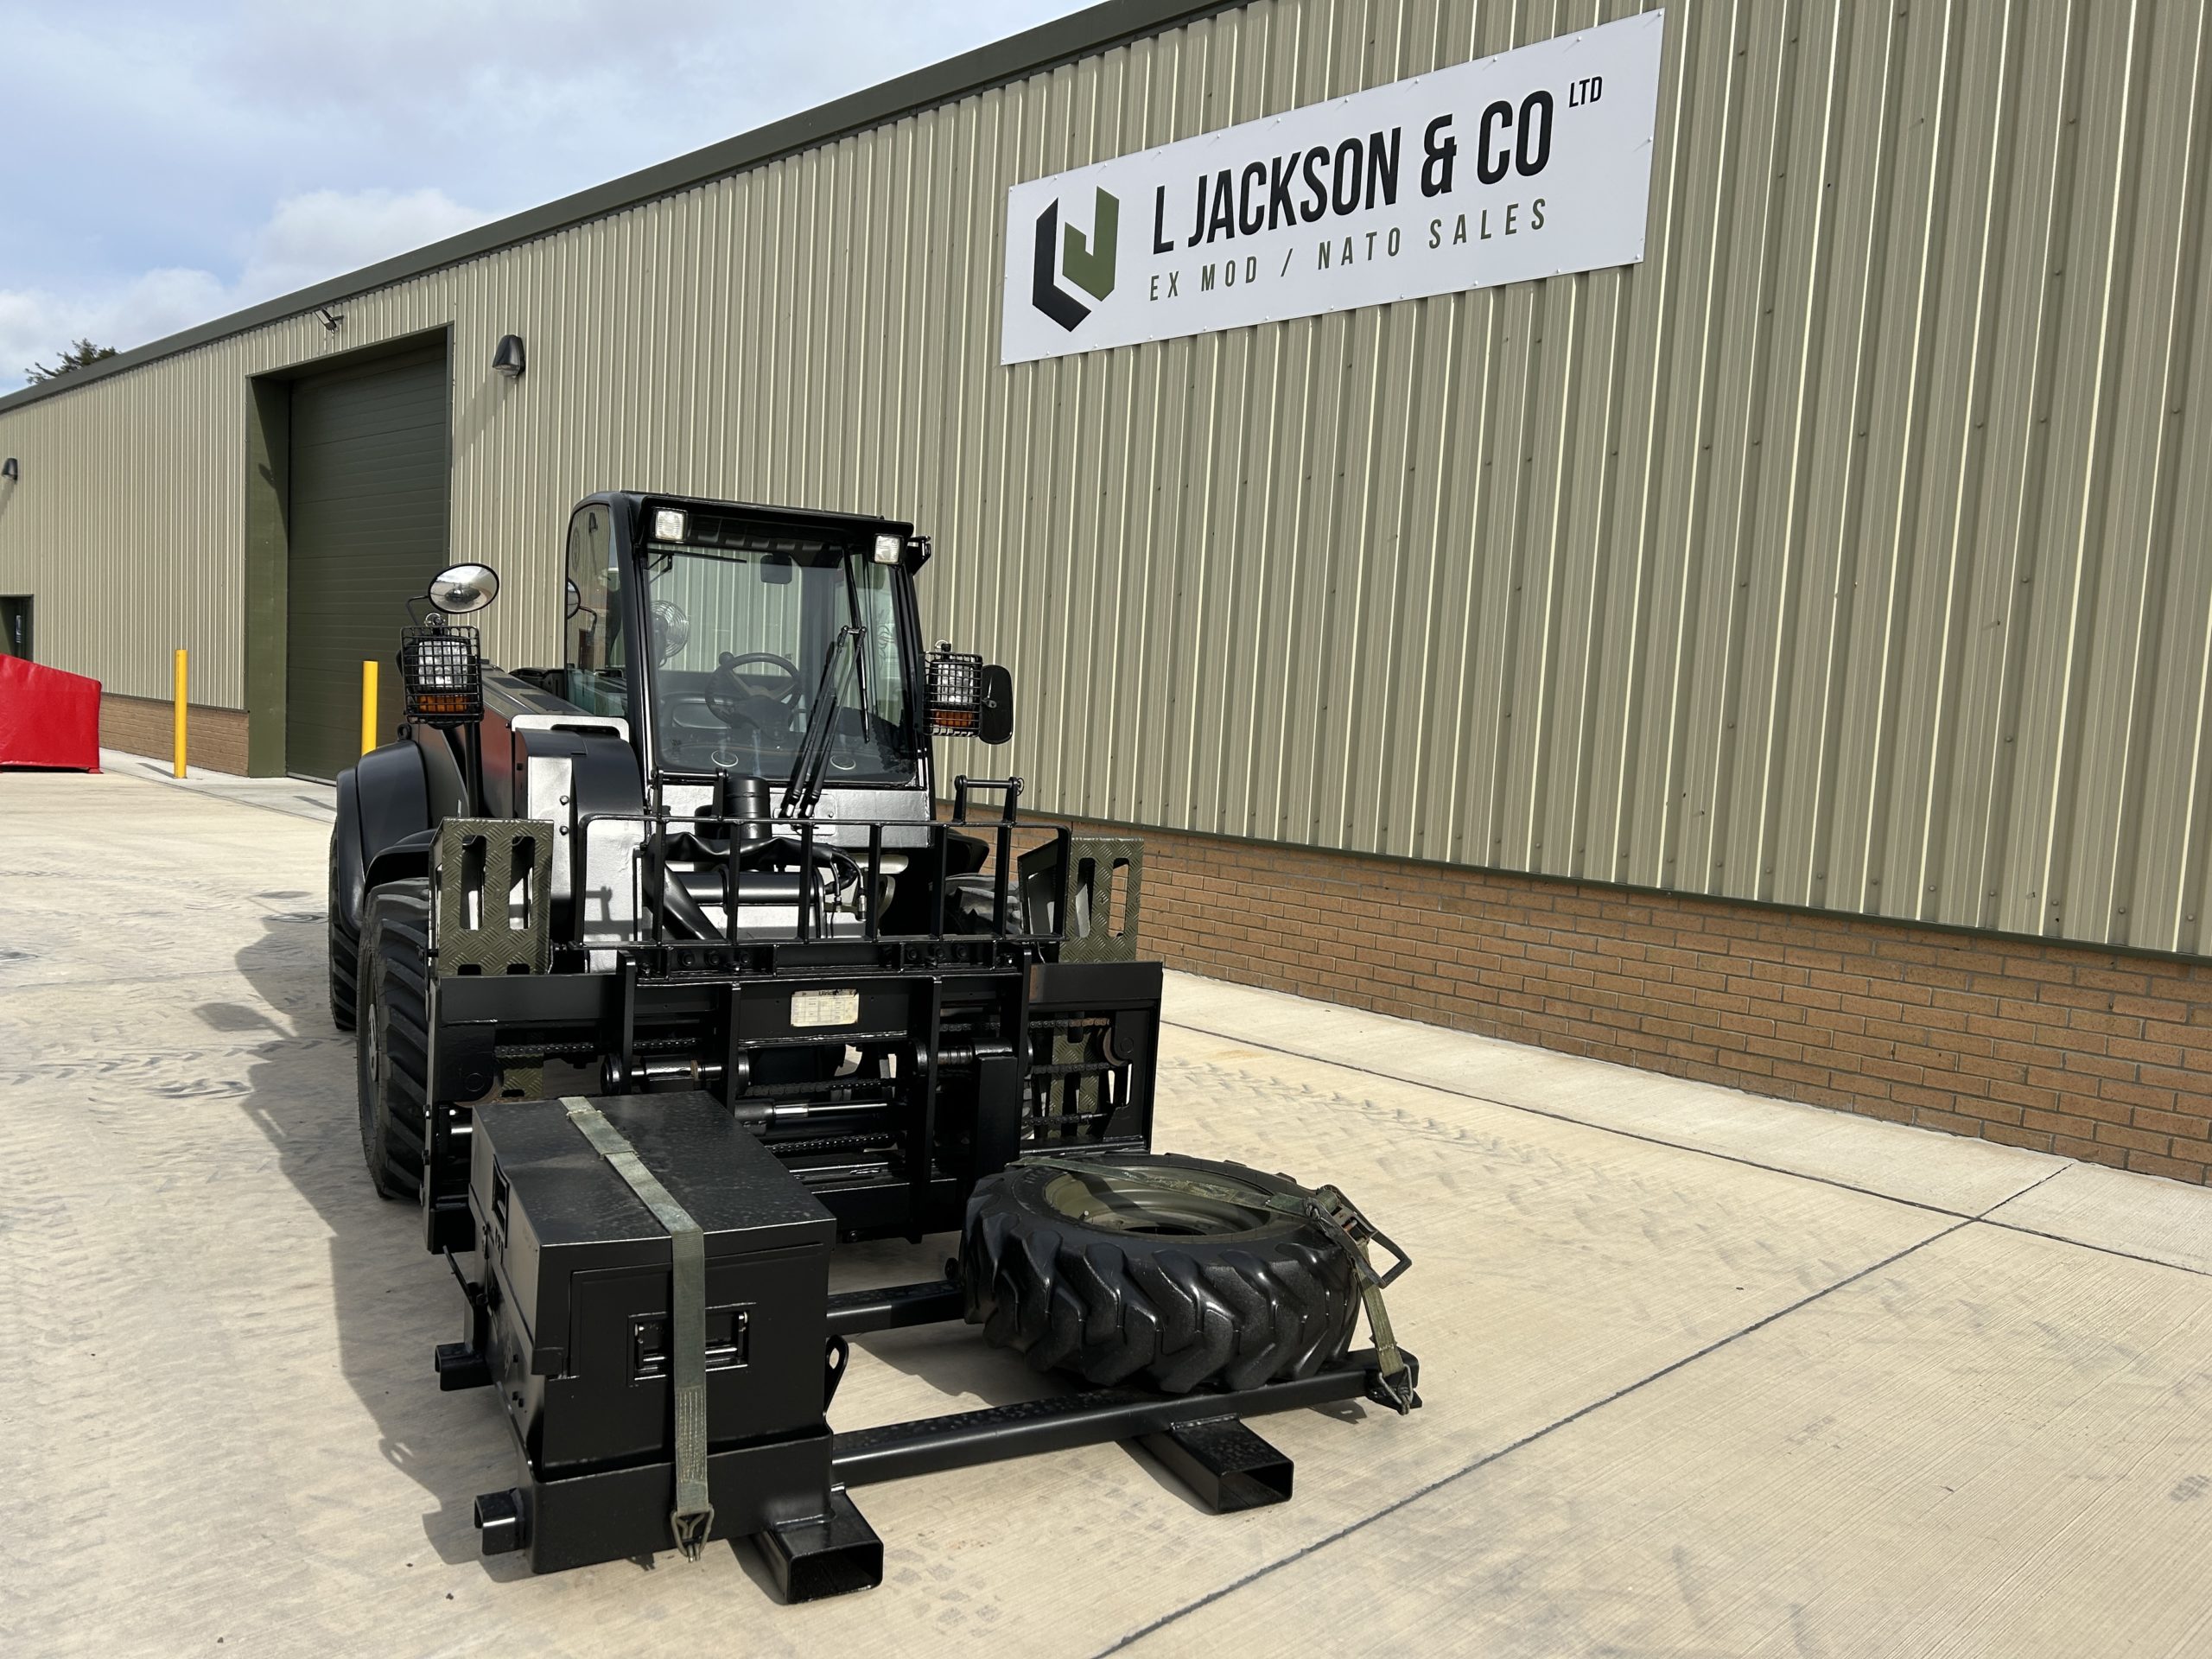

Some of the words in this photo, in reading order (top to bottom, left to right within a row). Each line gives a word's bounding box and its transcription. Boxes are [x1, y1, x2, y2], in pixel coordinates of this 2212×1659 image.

[1154, 186, 1175, 255] L
[1188, 127, 1402, 248] JACKSON
[1421, 114, 1458, 198] &
[1478, 90, 1554, 185] CO
[1568, 75, 1603, 109] LTD
[1150, 270, 1179, 302] EX
[1201, 256, 1257, 292] MOD
[1281, 248, 1294, 277] /
[1319, 226, 1401, 270] NATO
[1429, 198, 1546, 250] SALES
